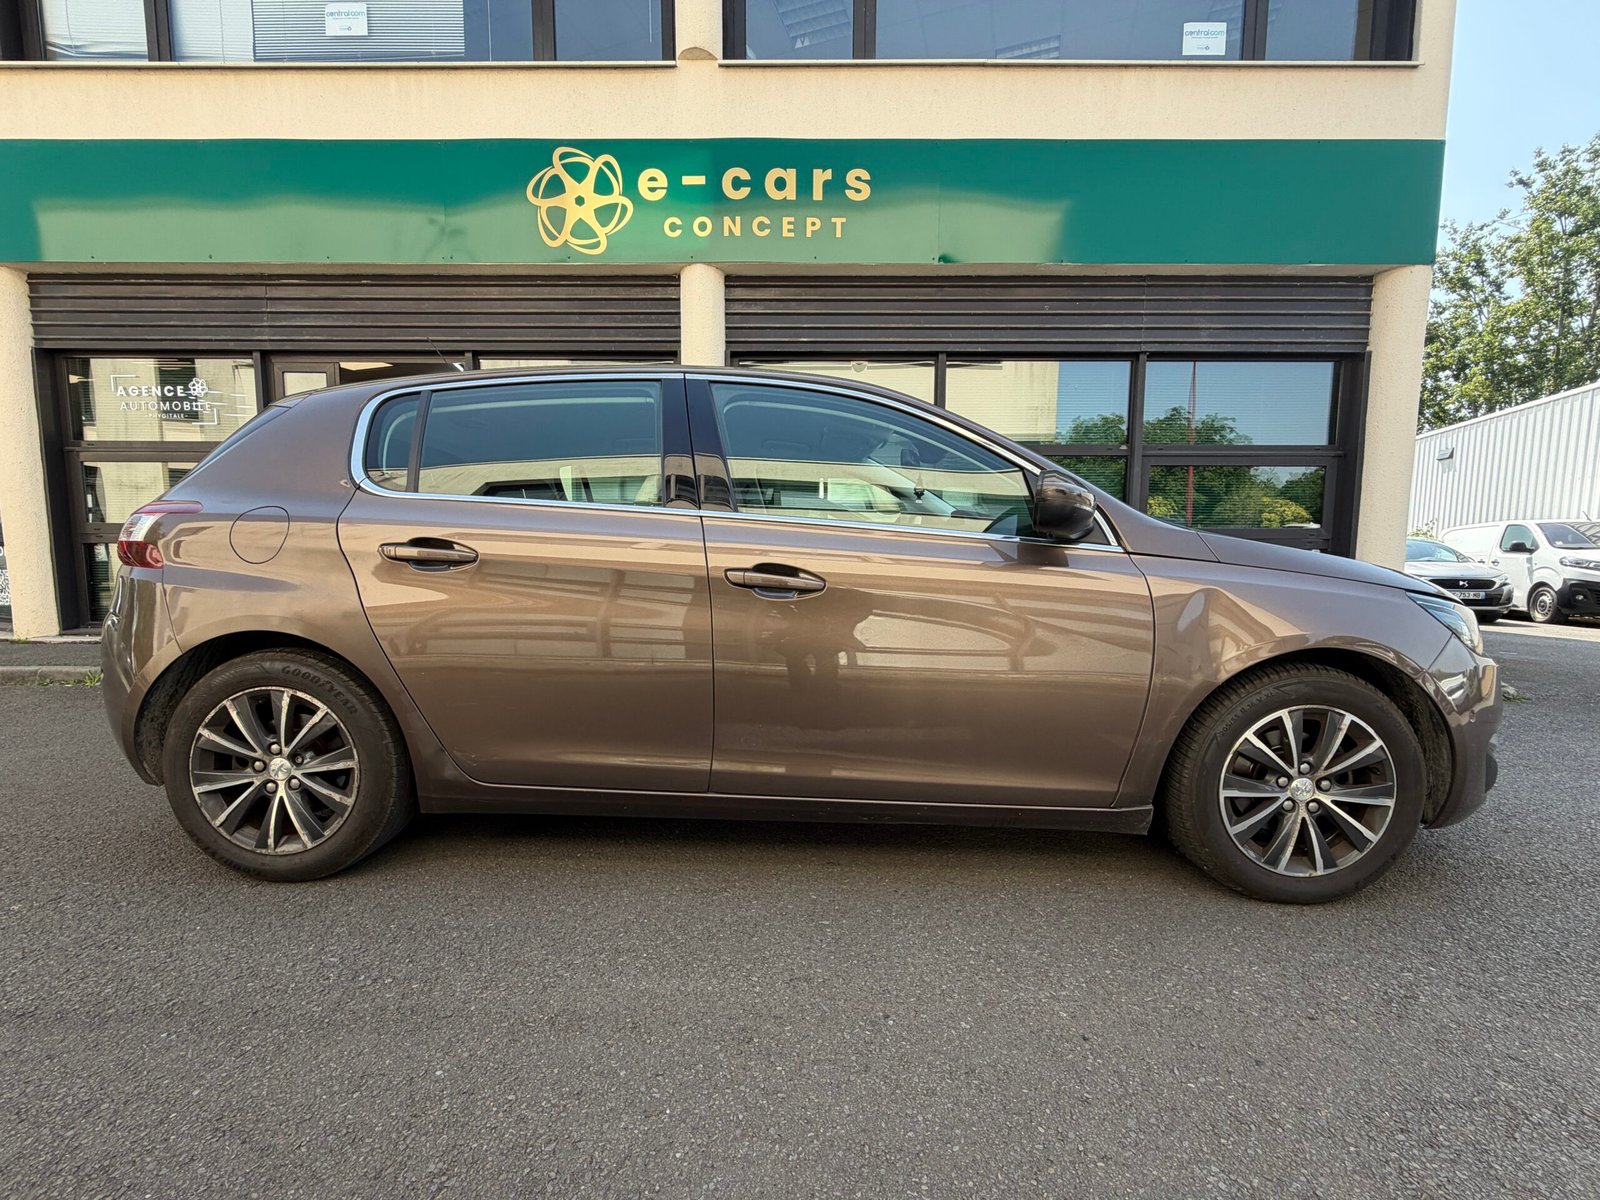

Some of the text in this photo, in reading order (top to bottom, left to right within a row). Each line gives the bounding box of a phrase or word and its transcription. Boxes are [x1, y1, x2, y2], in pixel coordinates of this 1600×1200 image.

[664, 216, 847, 238] CONCEPT
[116, 385, 186, 397] AGENCE
[119, 401, 212, 411] AUTOMOBILE
[281, 665, 358, 714] GOODYEAR
